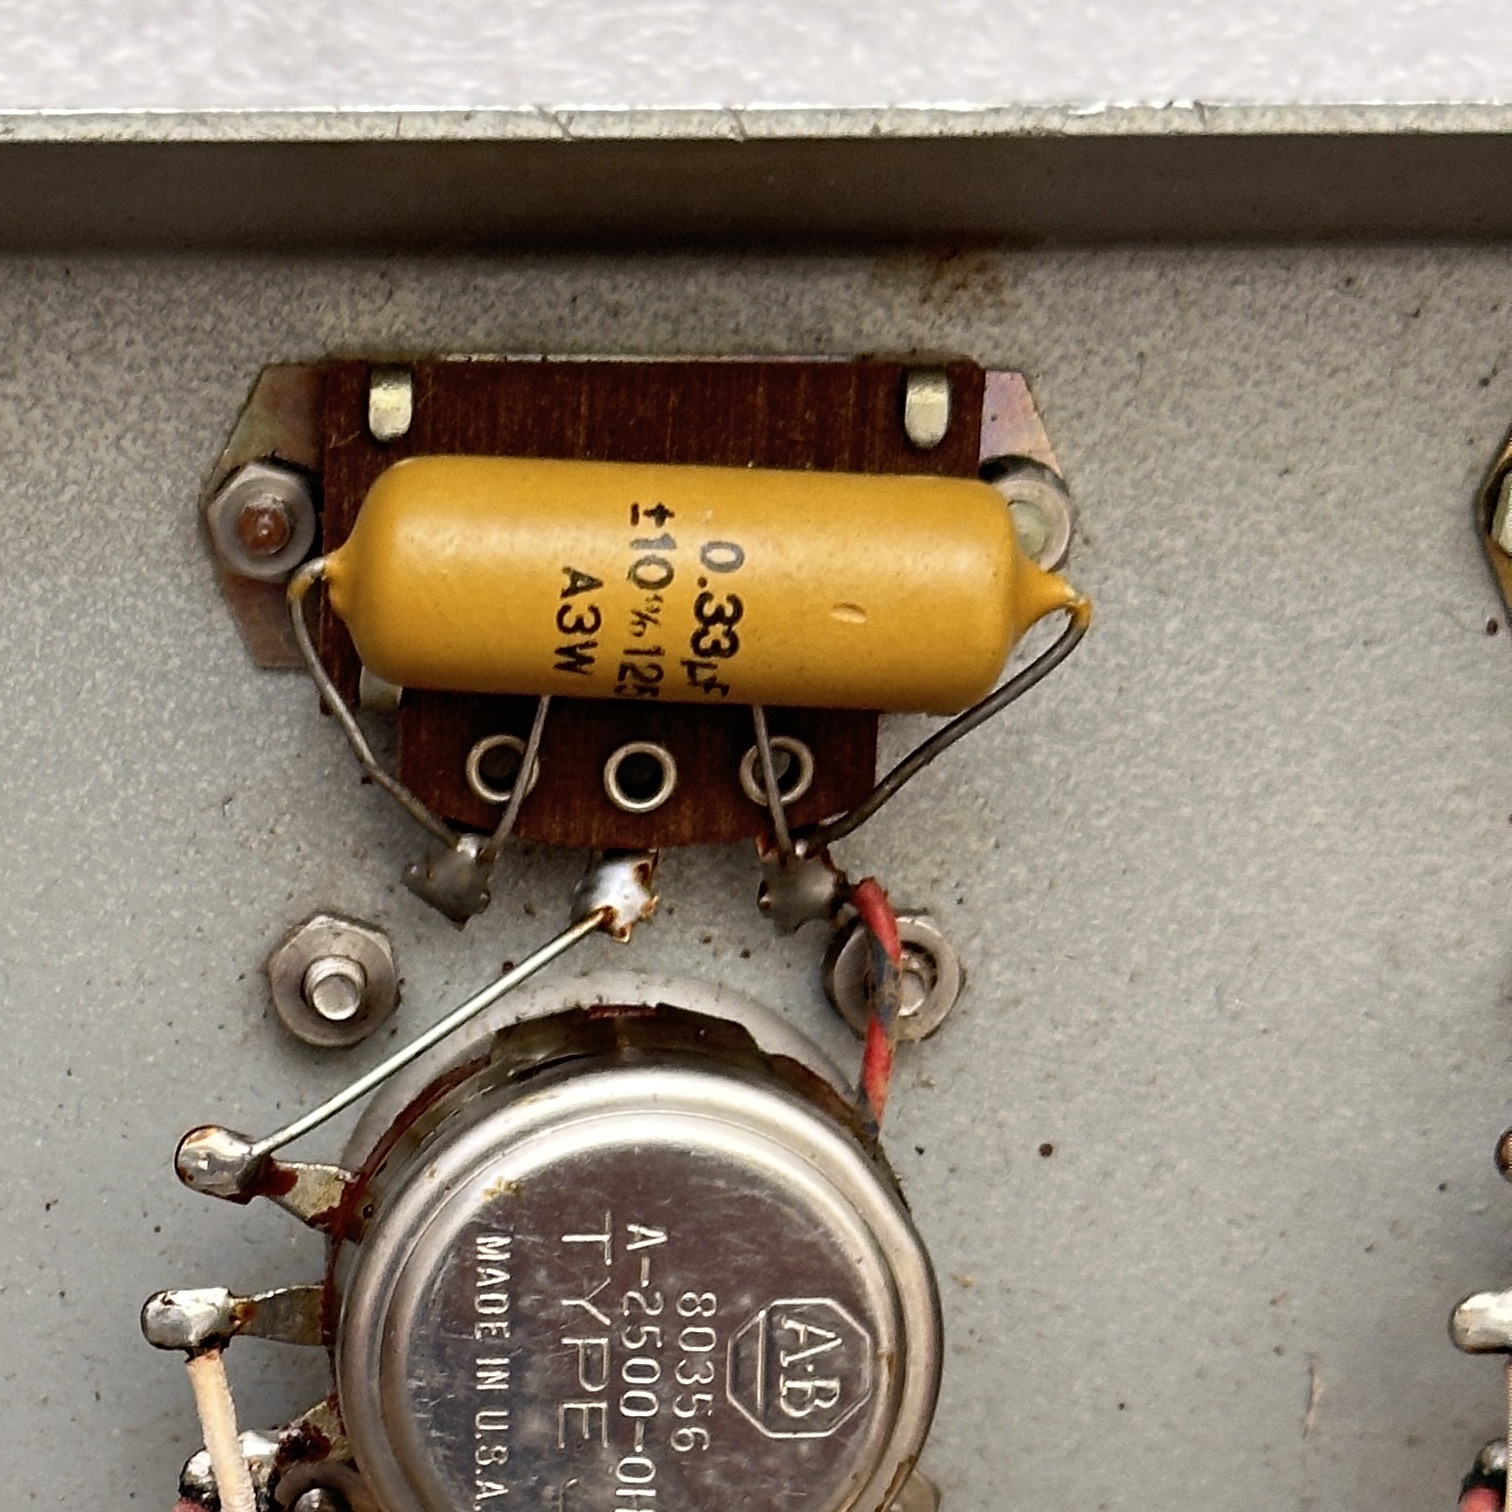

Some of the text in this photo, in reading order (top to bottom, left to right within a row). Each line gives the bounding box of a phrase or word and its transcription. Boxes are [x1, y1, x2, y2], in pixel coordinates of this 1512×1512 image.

[473, 1235, 511, 1512] MADE IN U.S.A.
[557, 1210, 612, 1449] TYPE
[671, 1291, 717, 1453] 80356
